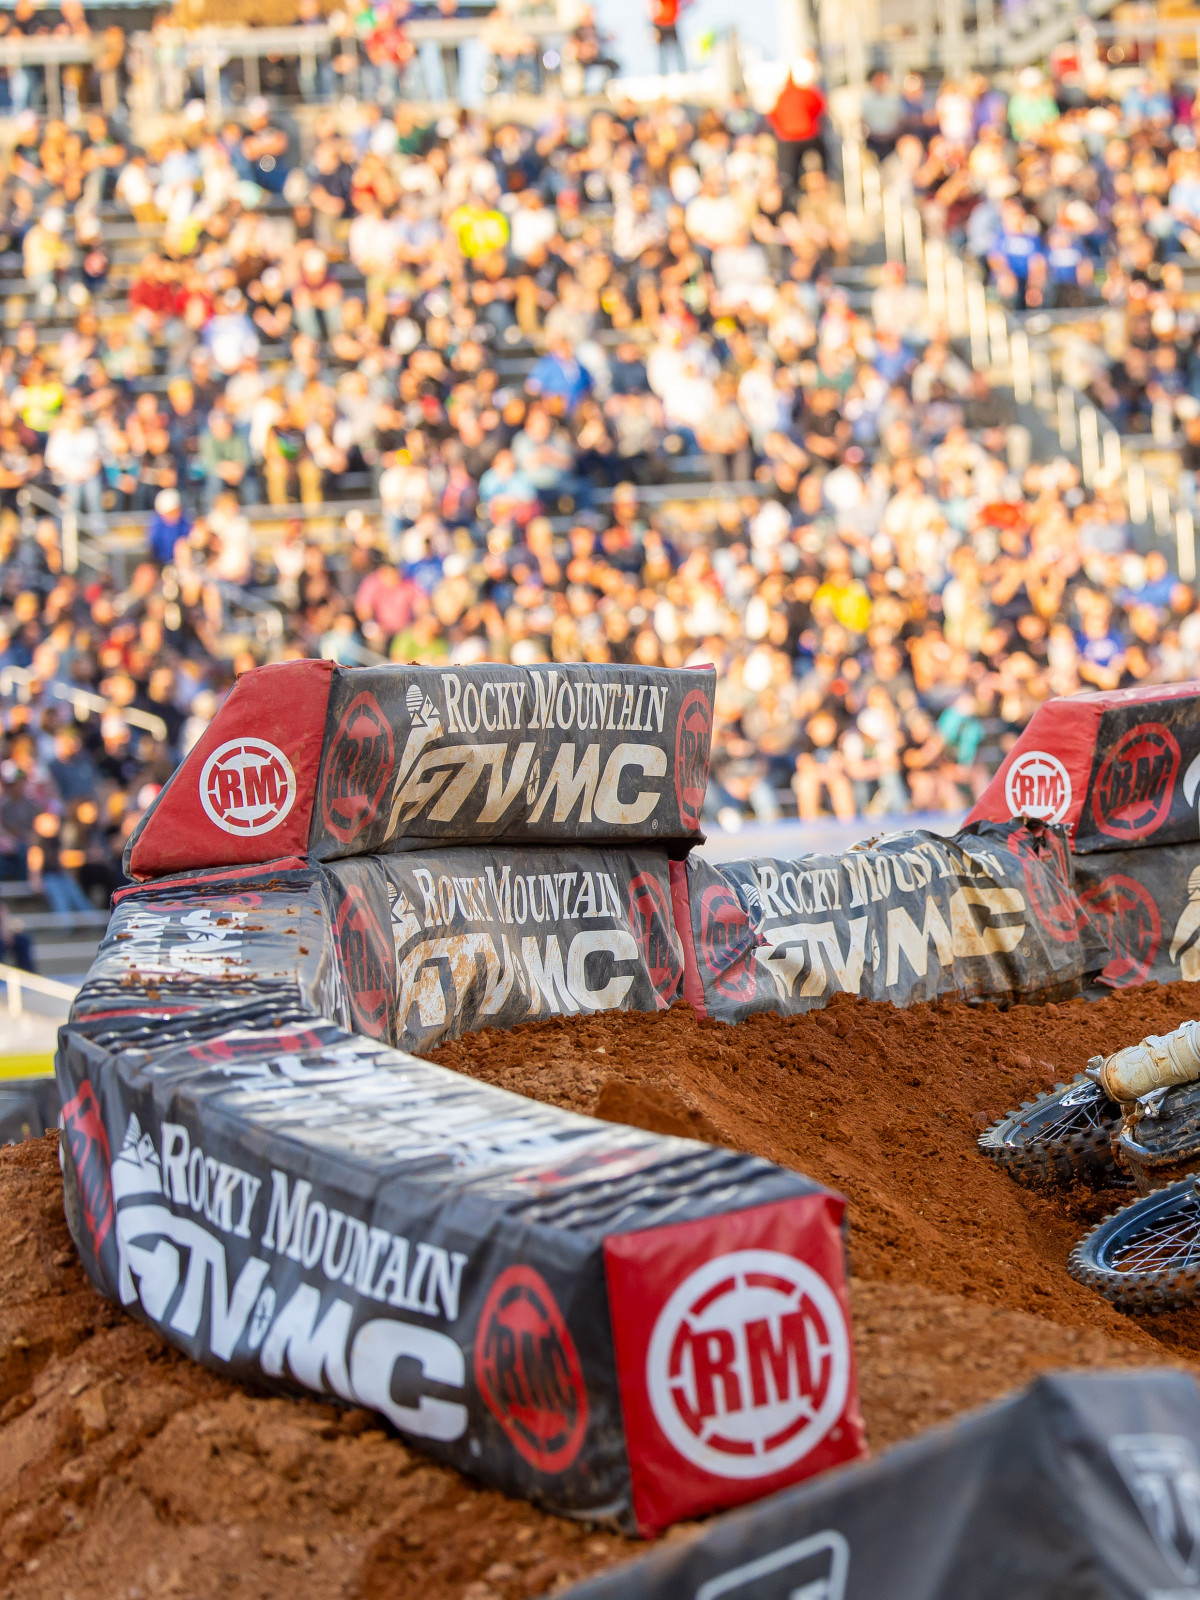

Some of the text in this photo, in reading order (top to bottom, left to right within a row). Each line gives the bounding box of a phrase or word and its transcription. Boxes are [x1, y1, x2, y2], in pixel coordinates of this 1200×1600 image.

[442, 670, 669, 734] ROCKY MOUNTAIN
[217, 772, 282, 809] RM
[1019, 775, 1058, 807] RM
[412, 865, 623, 929] ROCKY MOUNTAIN
[757, 864, 842, 919] ROCKY
[161, 1121, 468, 1322] ROCKY MOUNTAIN
[691, 1311, 815, 1427] RM
